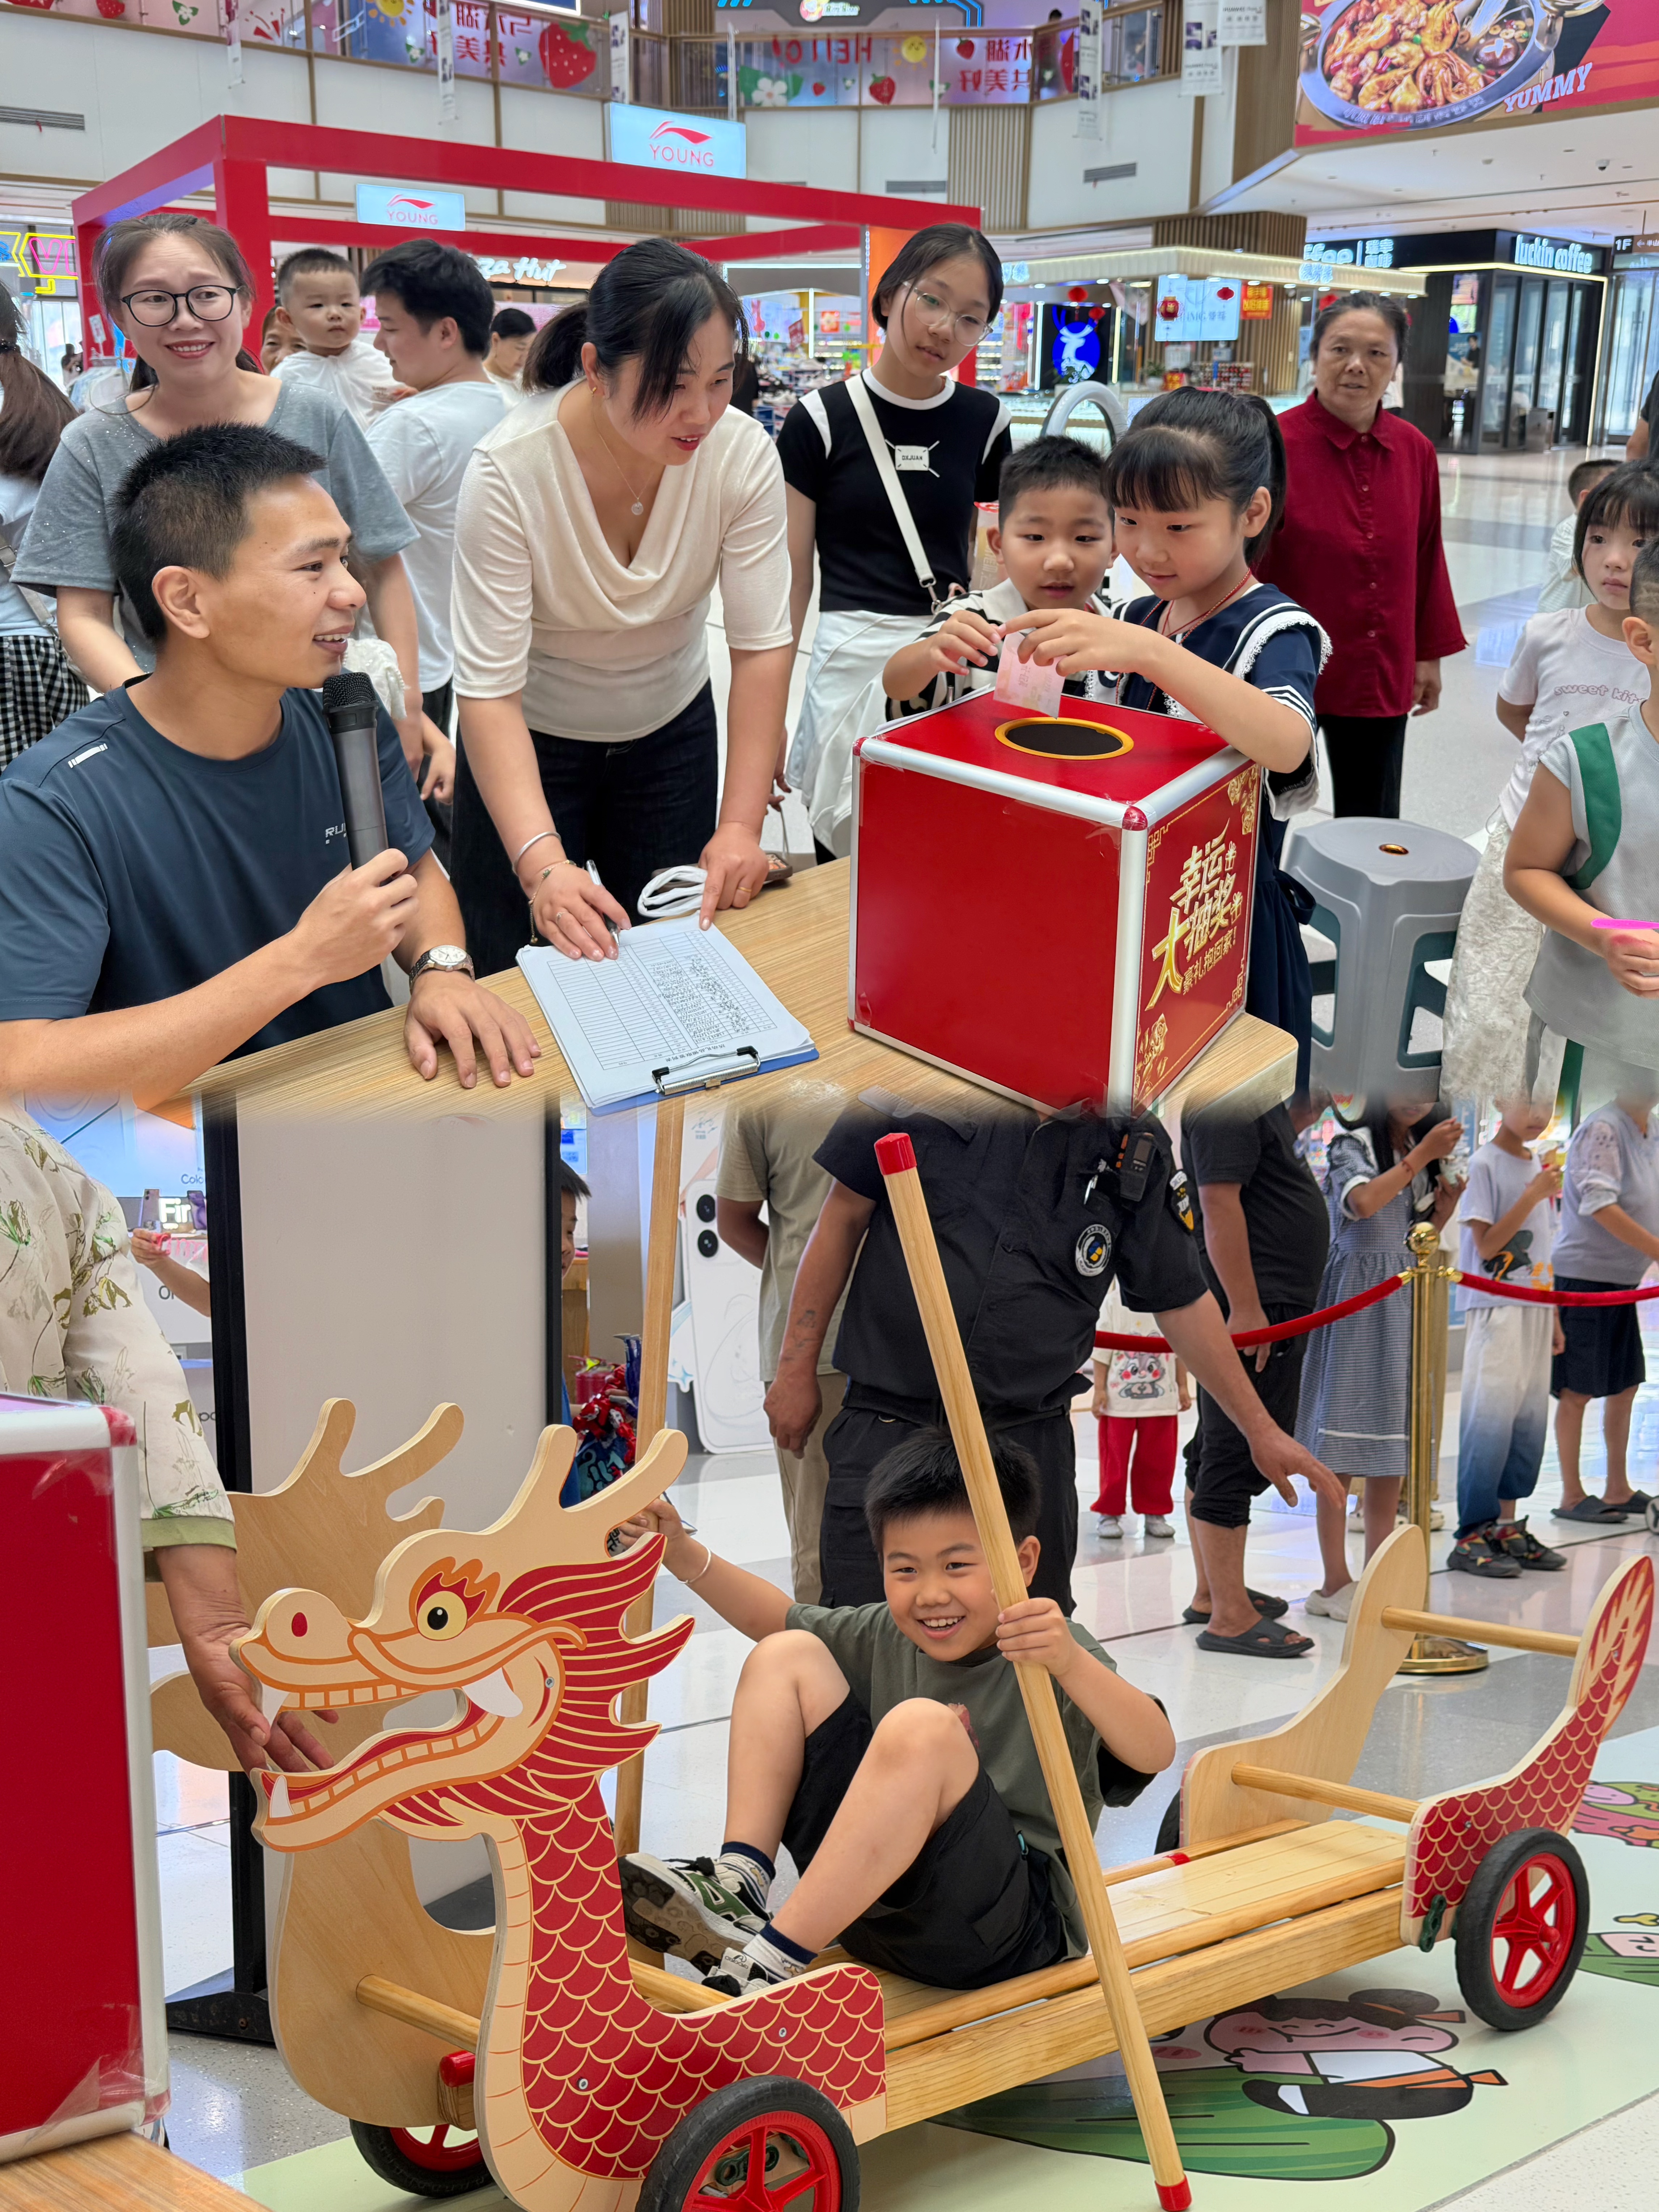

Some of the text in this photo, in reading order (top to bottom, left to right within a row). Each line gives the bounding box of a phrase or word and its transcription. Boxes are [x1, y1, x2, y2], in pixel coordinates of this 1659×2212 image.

[1504, 62, 1592, 113] YUMMY
[649, 144, 714, 167] YOUNG
[387, 209, 438, 225] YOUNG
[1515, 234, 1592, 274] luckin coffee
[1615, 238, 1632, 251] 1F
[513, 257, 567, 282] Hut
[1554, 684, 1609, 696] sweet
[326, 823, 346, 838] RU
[1170, 818, 1230, 915] 幸运
[1145, 873, 1236, 1012] 大抽奖
